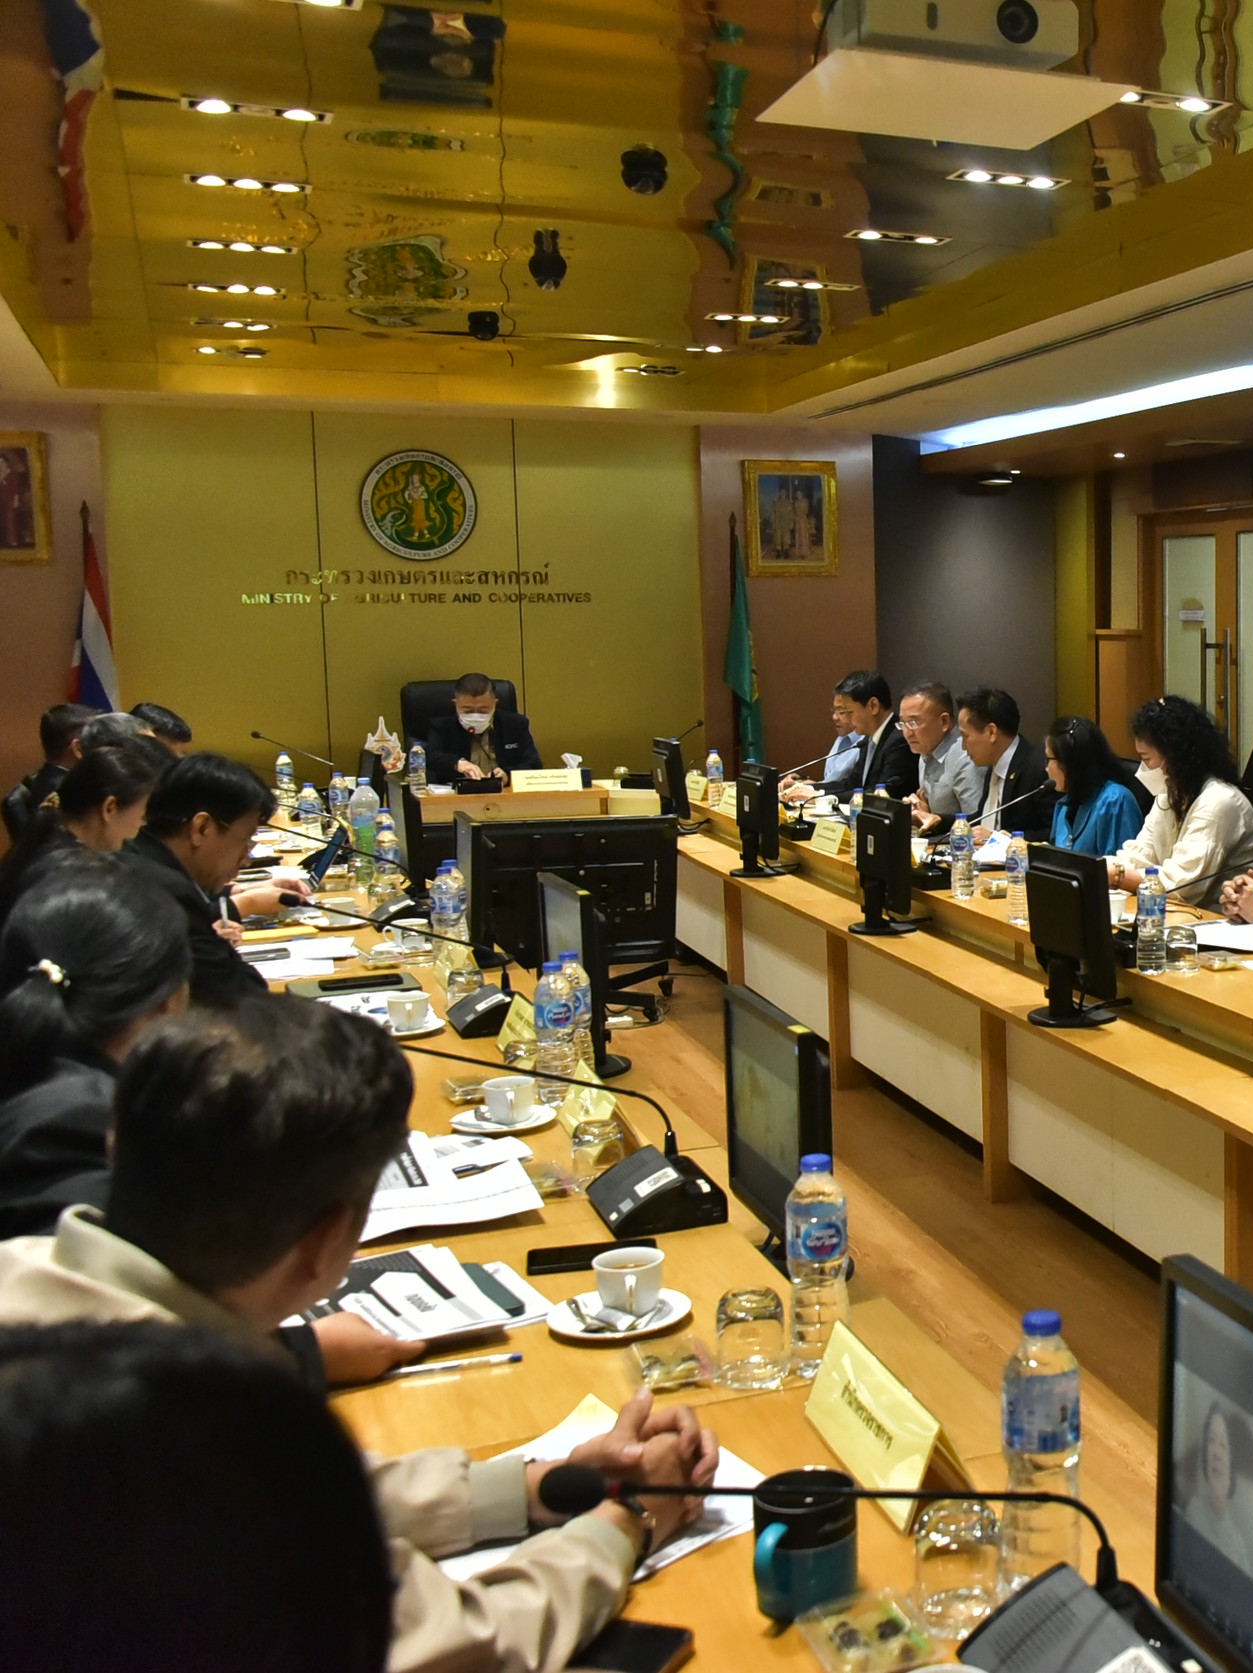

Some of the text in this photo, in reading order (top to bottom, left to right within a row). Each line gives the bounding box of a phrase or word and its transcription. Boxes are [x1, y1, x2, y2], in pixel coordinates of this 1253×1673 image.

[241, 593, 312, 605] MINISTRY
[352, 593, 446, 604] GRIUTURE
[452, 593, 482, 604] AND
[488, 592, 592, 604] COOPERATIVES
